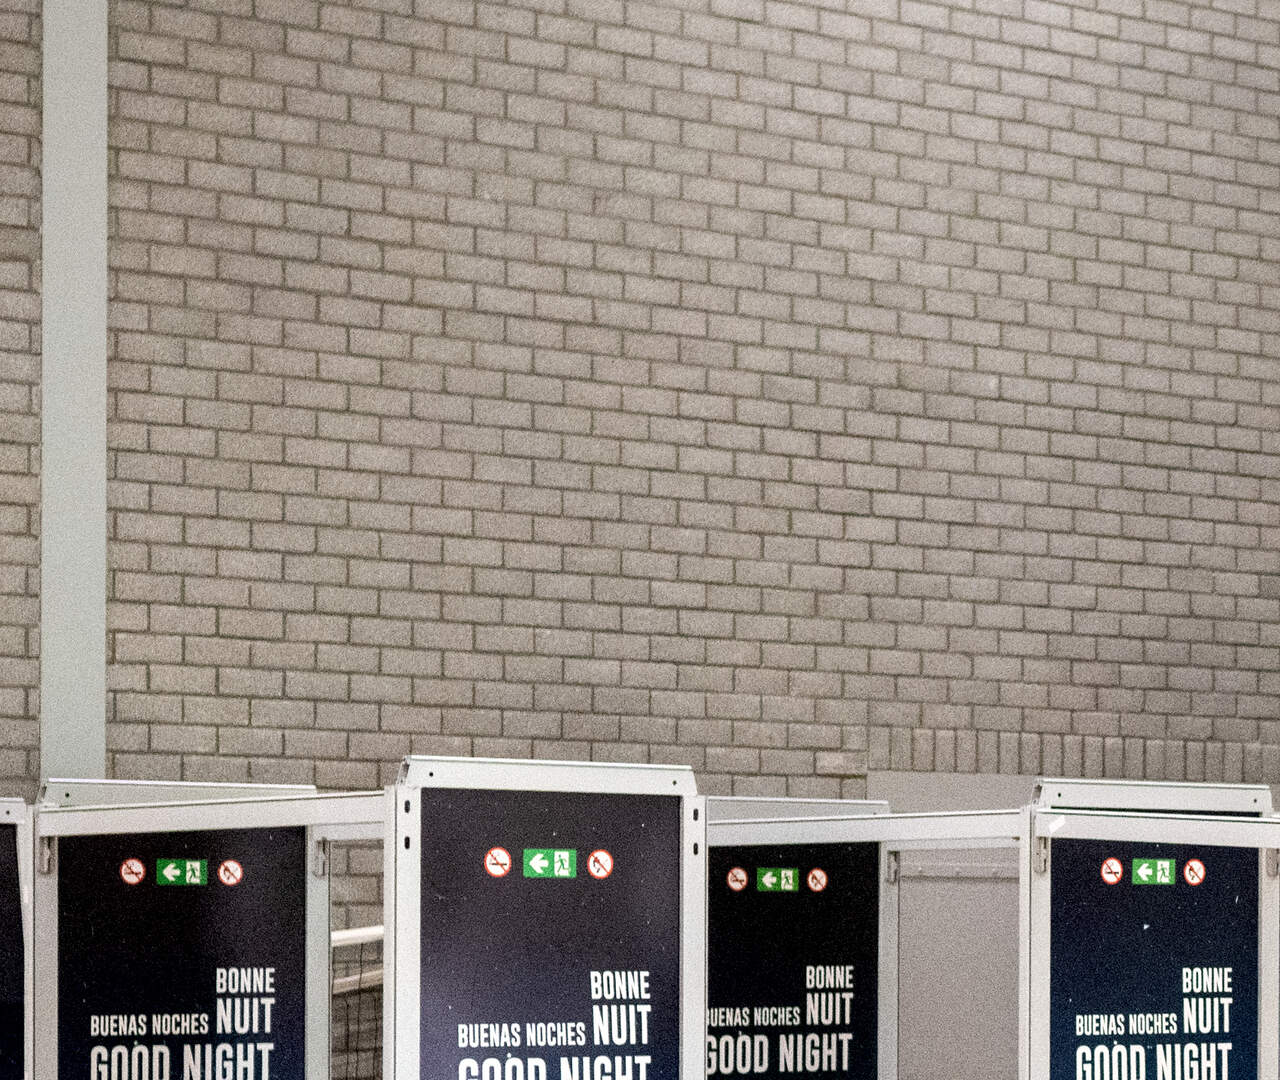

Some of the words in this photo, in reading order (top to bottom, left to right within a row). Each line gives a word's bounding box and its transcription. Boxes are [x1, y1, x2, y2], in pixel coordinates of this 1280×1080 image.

[216, 968, 275, 993] BONNE
[590, 971, 650, 999] BONNE
[806, 965, 854, 988] BONNE
[1182, 968, 1232, 993] BONNE
[216, 998, 275, 1034] NUIT
[754, 1007, 800, 1026] NOCHES
[806, 992, 854, 1025] NUIT
[1183, 997, 1233, 1033] NUIT
[91, 1015, 147, 1036] BUENAS
[152, 1013, 209, 1035] NOCHES
[458, 1023, 521, 1048] BUENAS
[526, 1022, 586, 1046] NOCHES
[592, 1004, 651, 1045] NUIT
[1076, 1014, 1125, 1035] BUENAS
[1129, 1013, 1177, 1034] NOCHES
[707, 1034, 769, 1075] GOOD
[779, 1033, 853, 1072] NIGHT
